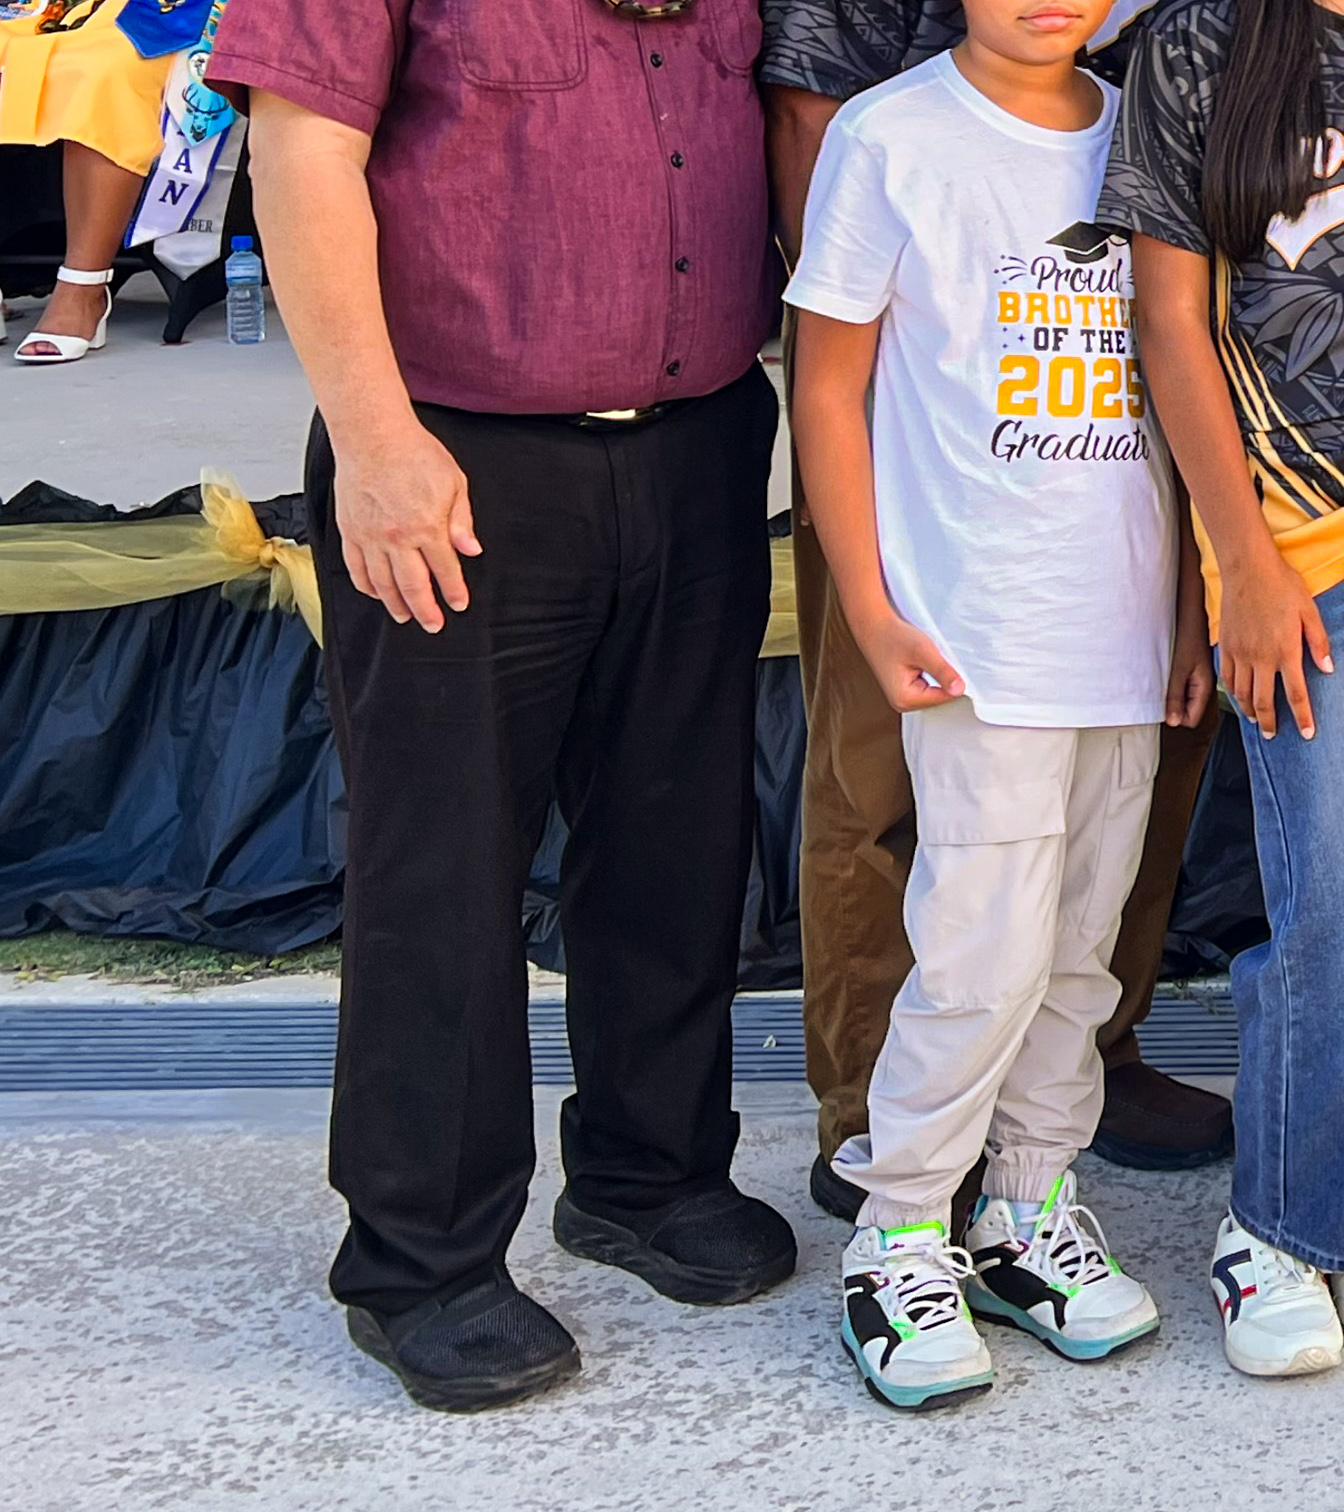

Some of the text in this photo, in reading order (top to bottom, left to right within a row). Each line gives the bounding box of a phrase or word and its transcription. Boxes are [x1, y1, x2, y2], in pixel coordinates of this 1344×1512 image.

[1030, 256, 1123, 294] Proud
[1033, 326, 1126, 354] OF THE
[996, 354, 1147, 420] 2025
